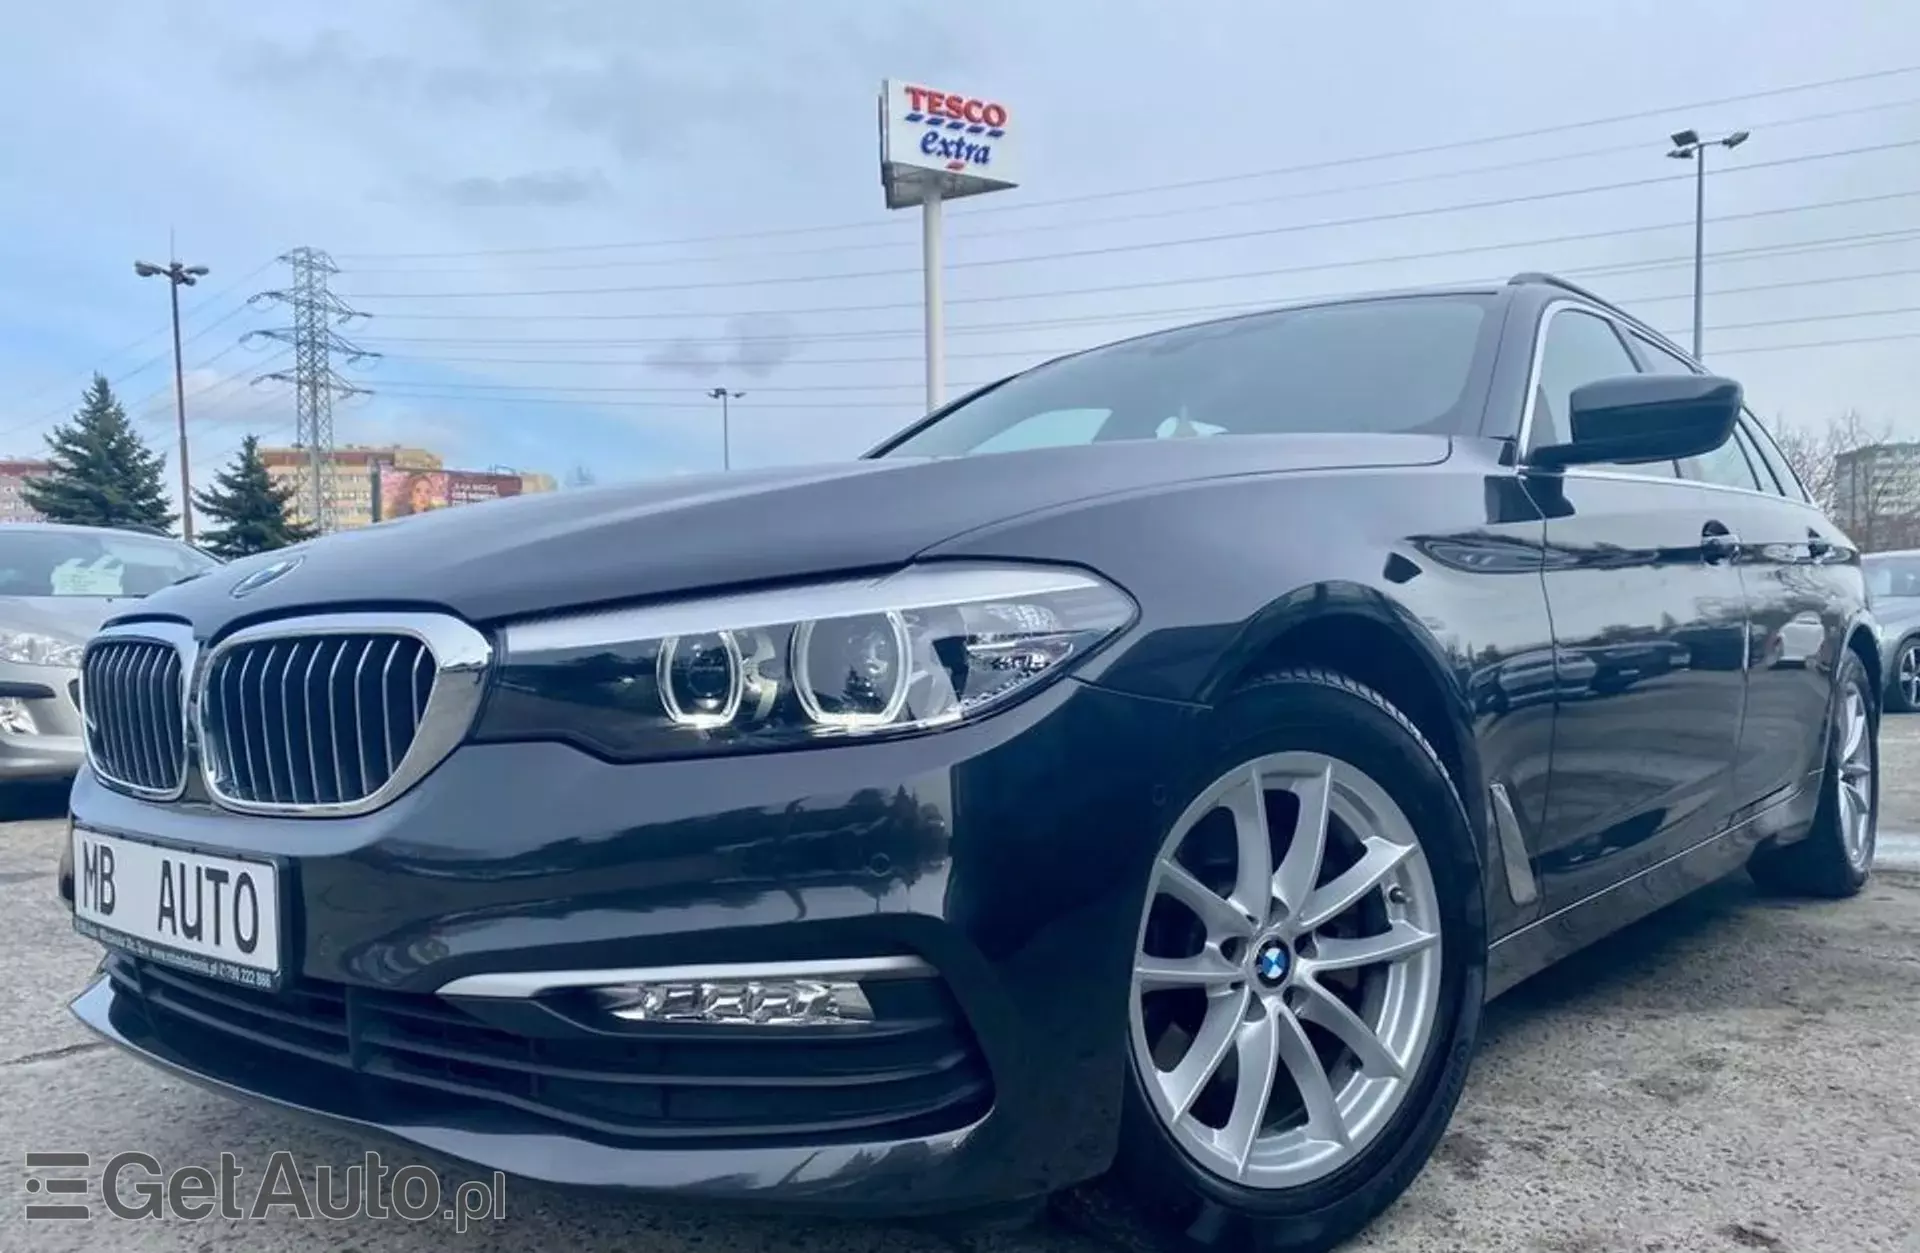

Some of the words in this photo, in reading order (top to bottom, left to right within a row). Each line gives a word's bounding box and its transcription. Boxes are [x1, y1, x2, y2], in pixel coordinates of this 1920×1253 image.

[904, 85, 1007, 127] TESCO
[921, 130, 990, 164] extra
[83, 841, 116, 916] MB
[158, 859, 259, 954] AUTO
